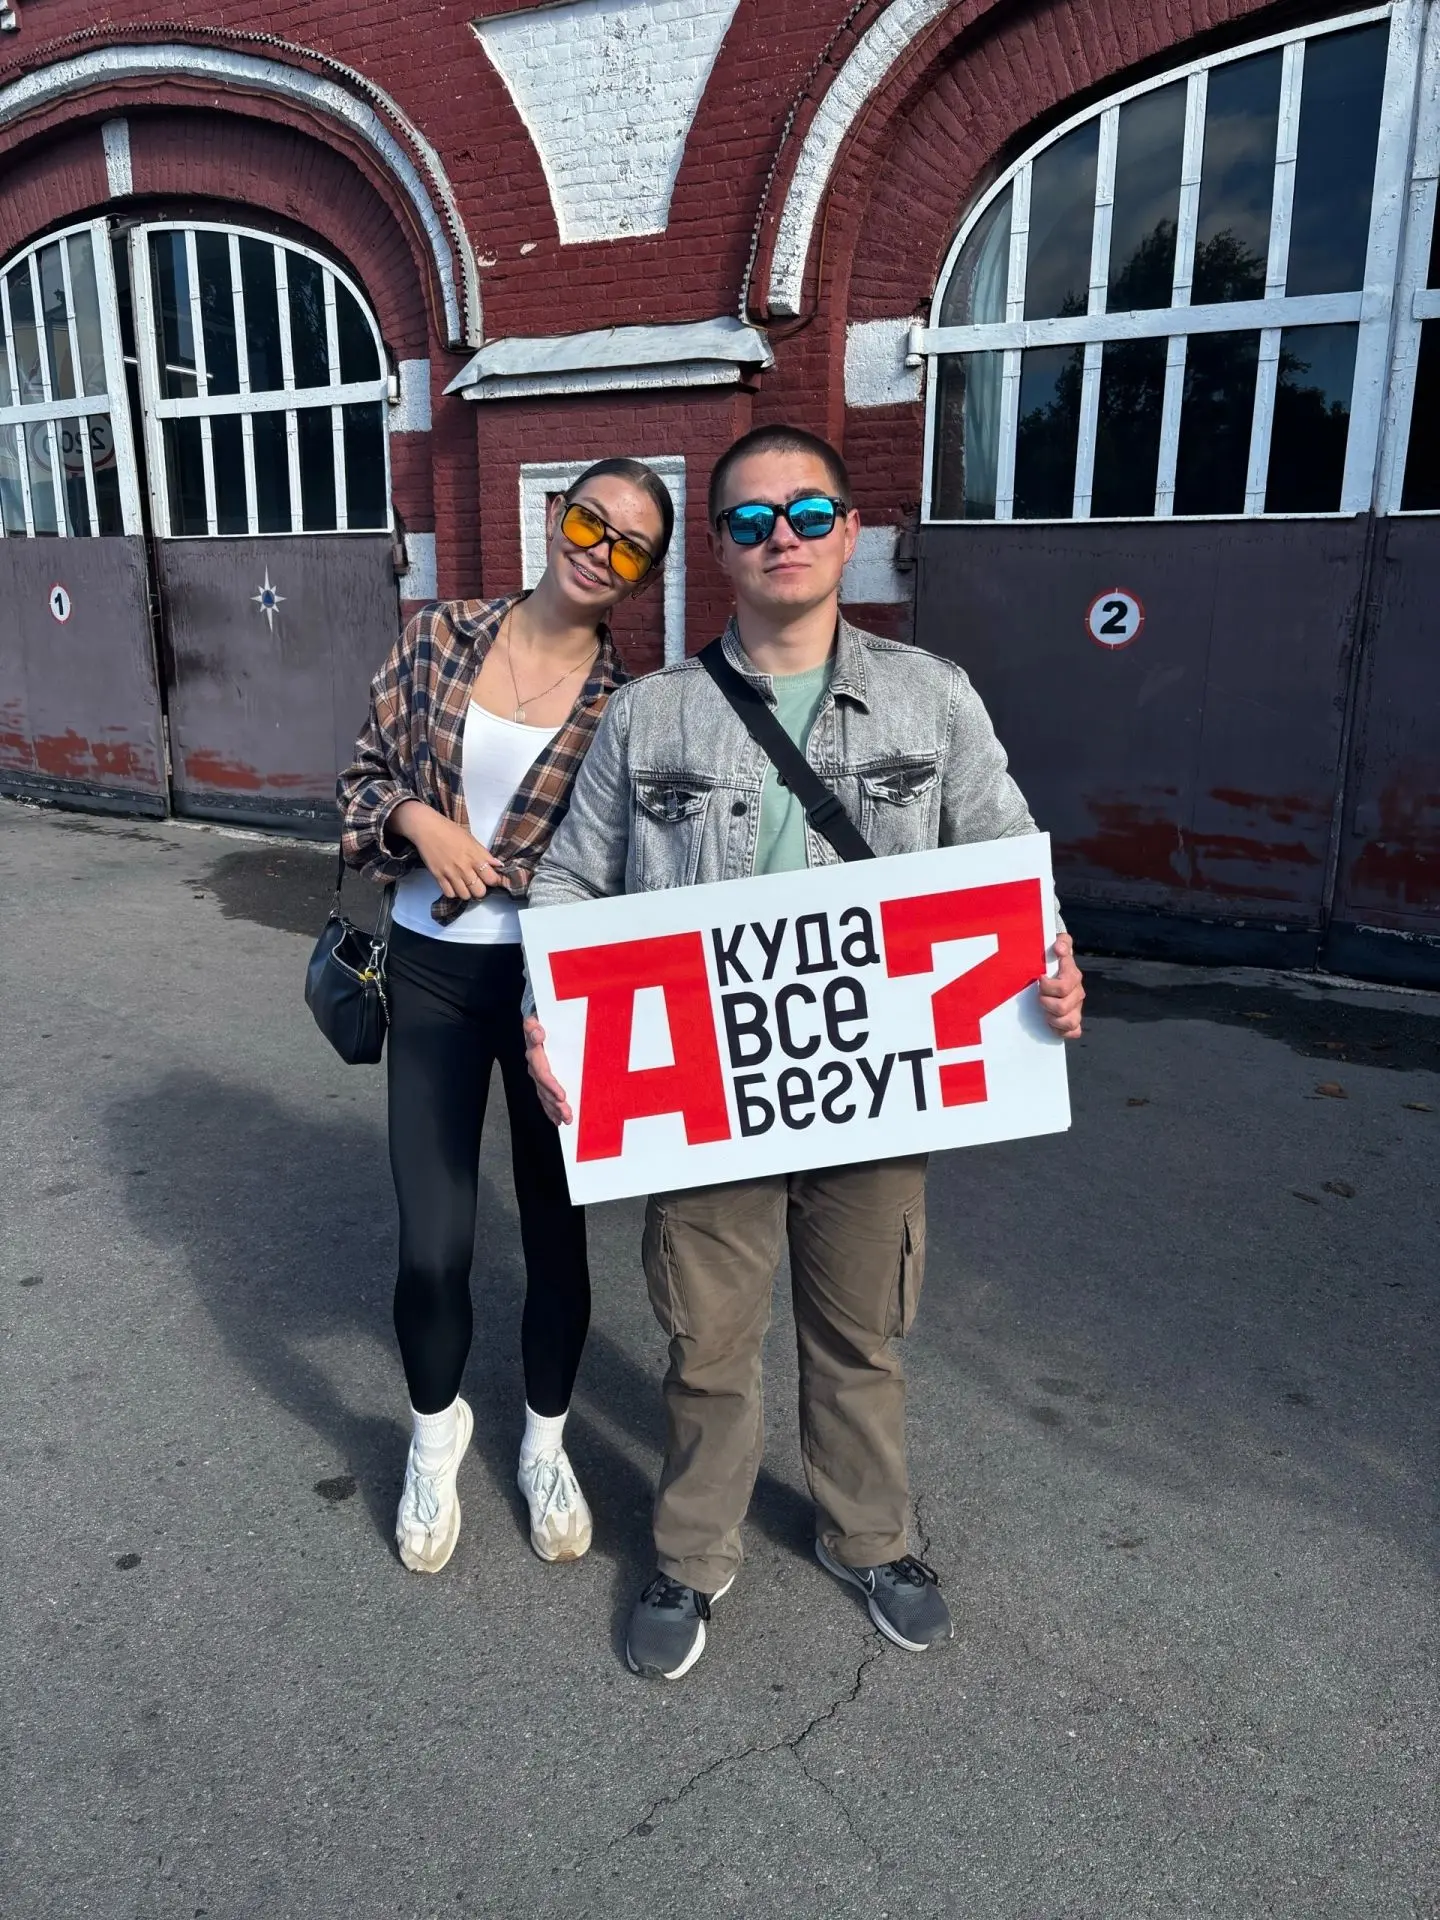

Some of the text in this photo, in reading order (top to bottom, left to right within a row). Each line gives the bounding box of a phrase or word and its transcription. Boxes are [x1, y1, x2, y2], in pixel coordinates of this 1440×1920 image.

[55, 593, 63, 615] 1
[1100, 601, 1127, 634] 2
[548, 931, 732, 1163] А
